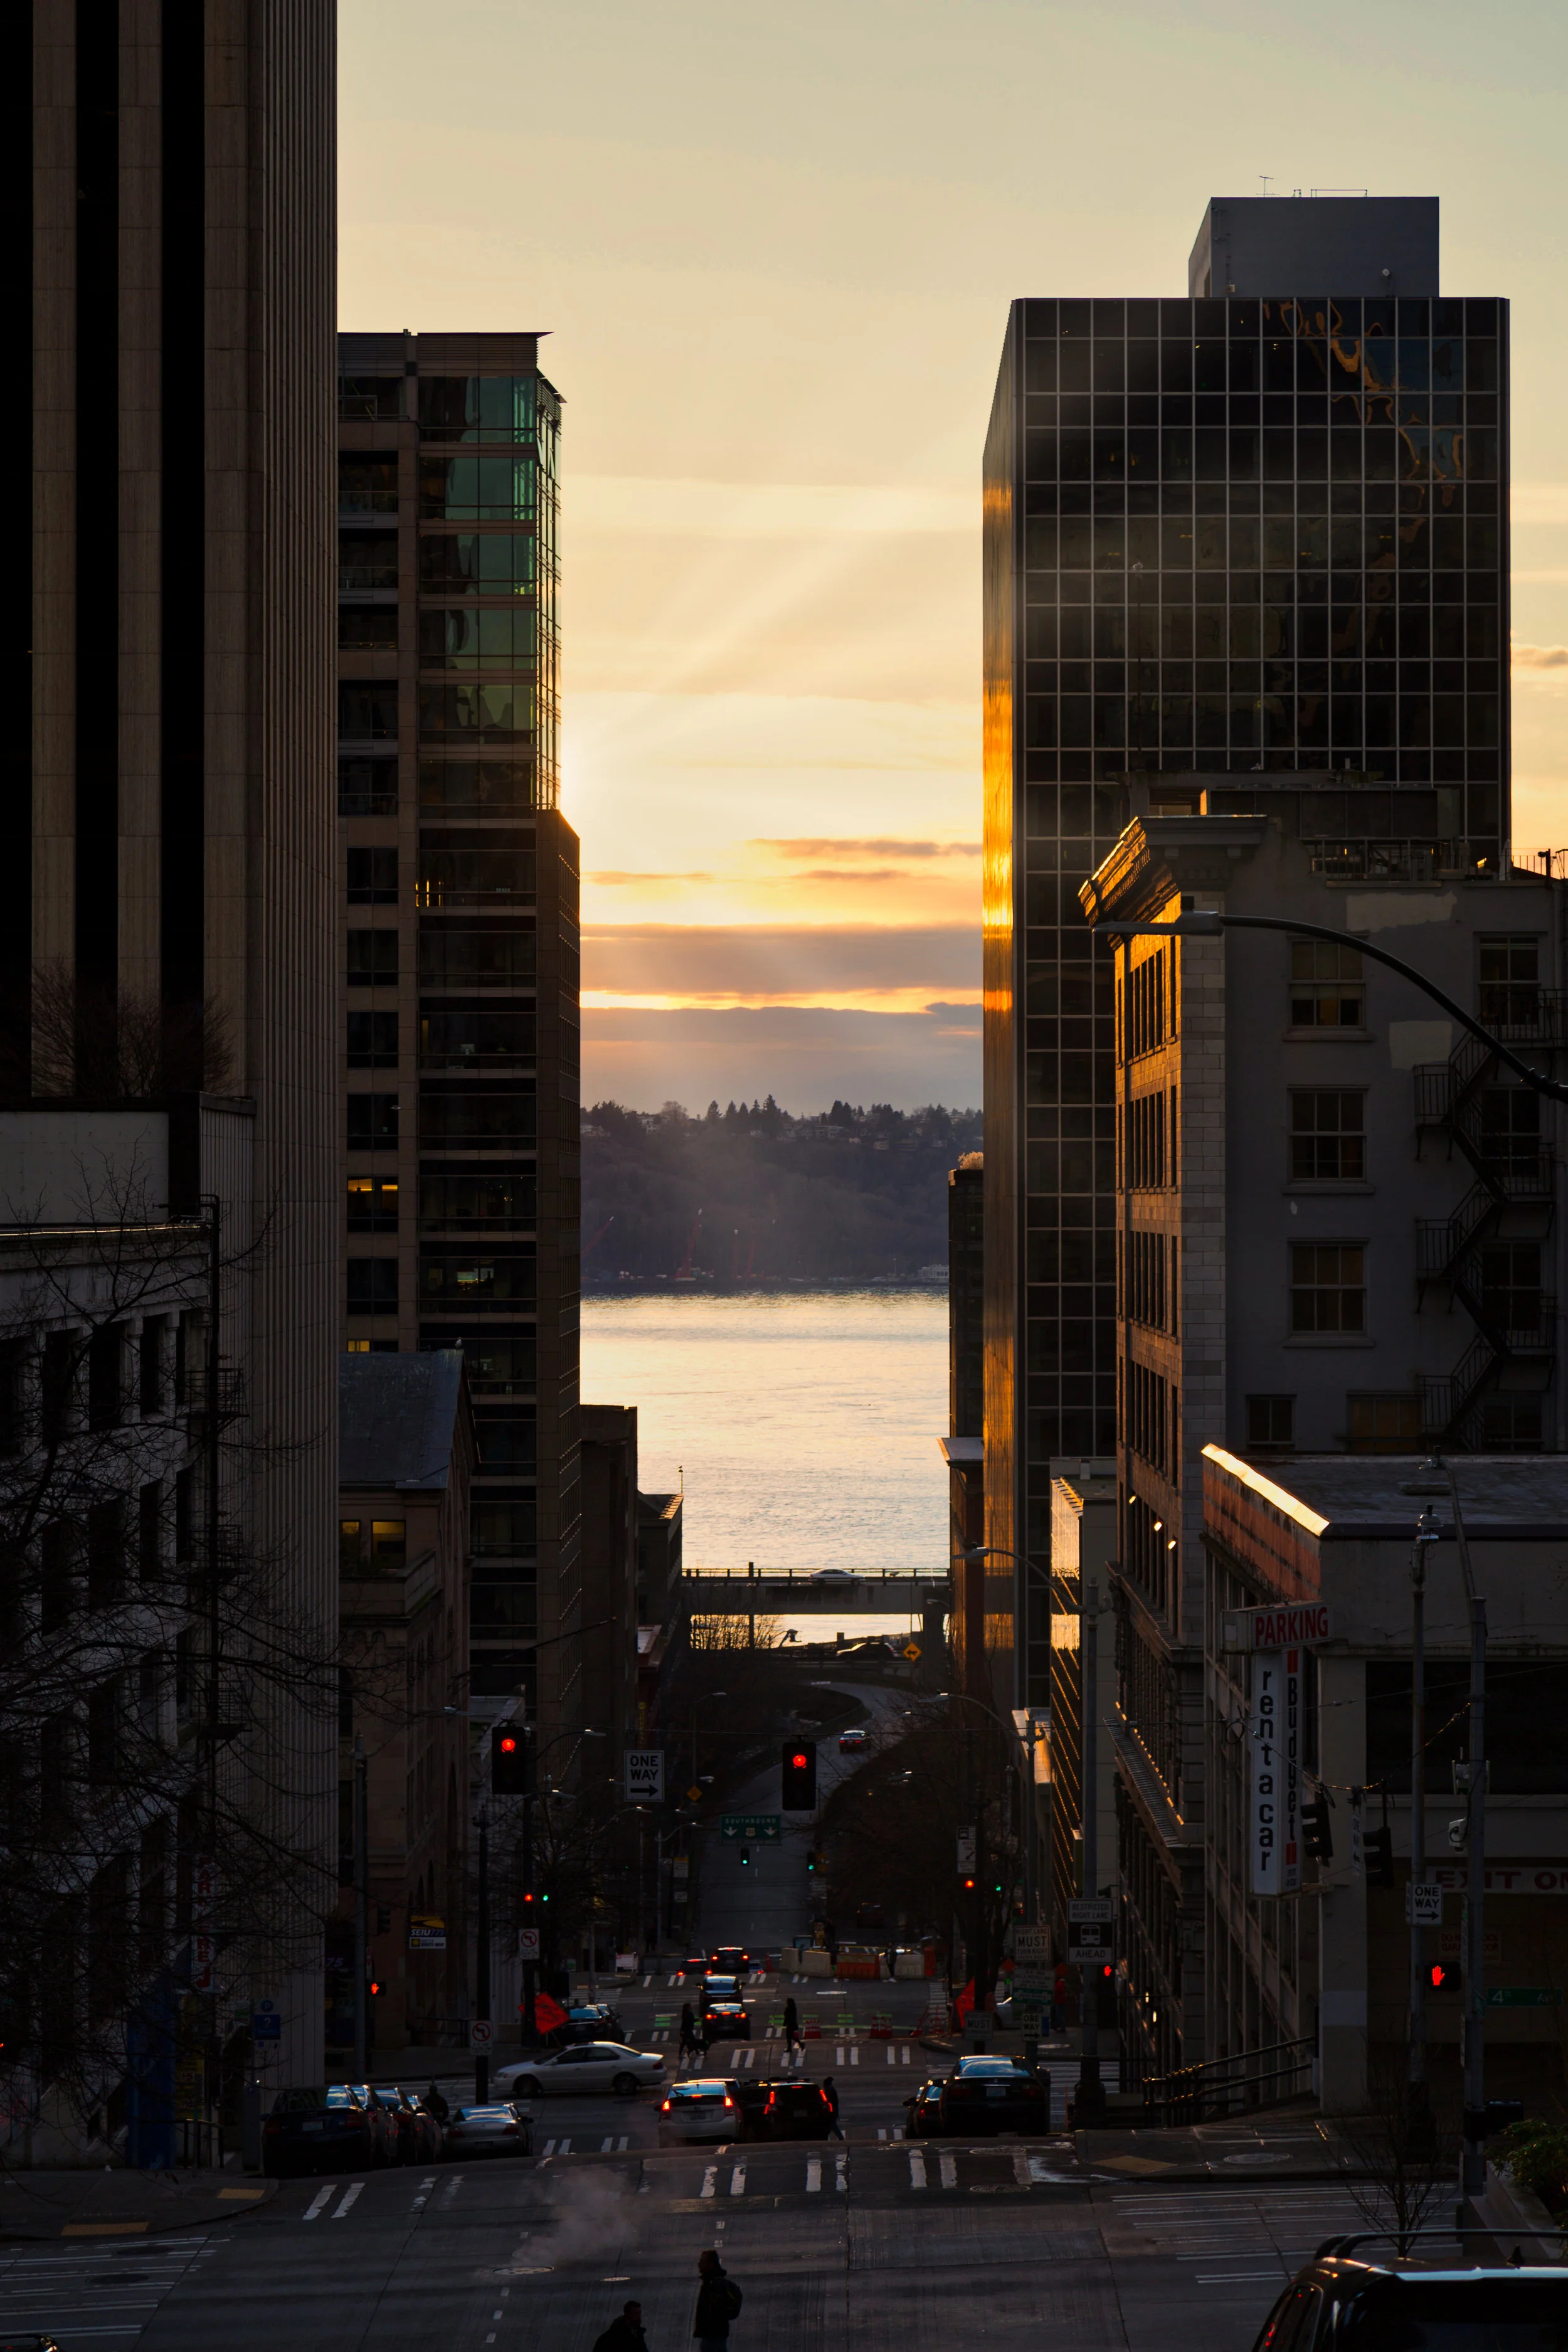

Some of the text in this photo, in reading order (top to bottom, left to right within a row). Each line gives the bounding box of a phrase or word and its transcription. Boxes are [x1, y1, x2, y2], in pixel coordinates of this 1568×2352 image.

[1256, 1607, 1328, 1646] PARKING
[630, 1756, 659, 1767] ONE
[630, 1769, 659, 1780] WAY
[1415, 1887, 1439, 1897] ONE
[1415, 1899, 1439, 1908] WAY
[1018, 1936, 1046, 1947] MUST
[1075, 1949, 1106, 1957] AHEAD
[967, 2019, 990, 2028] MUST
